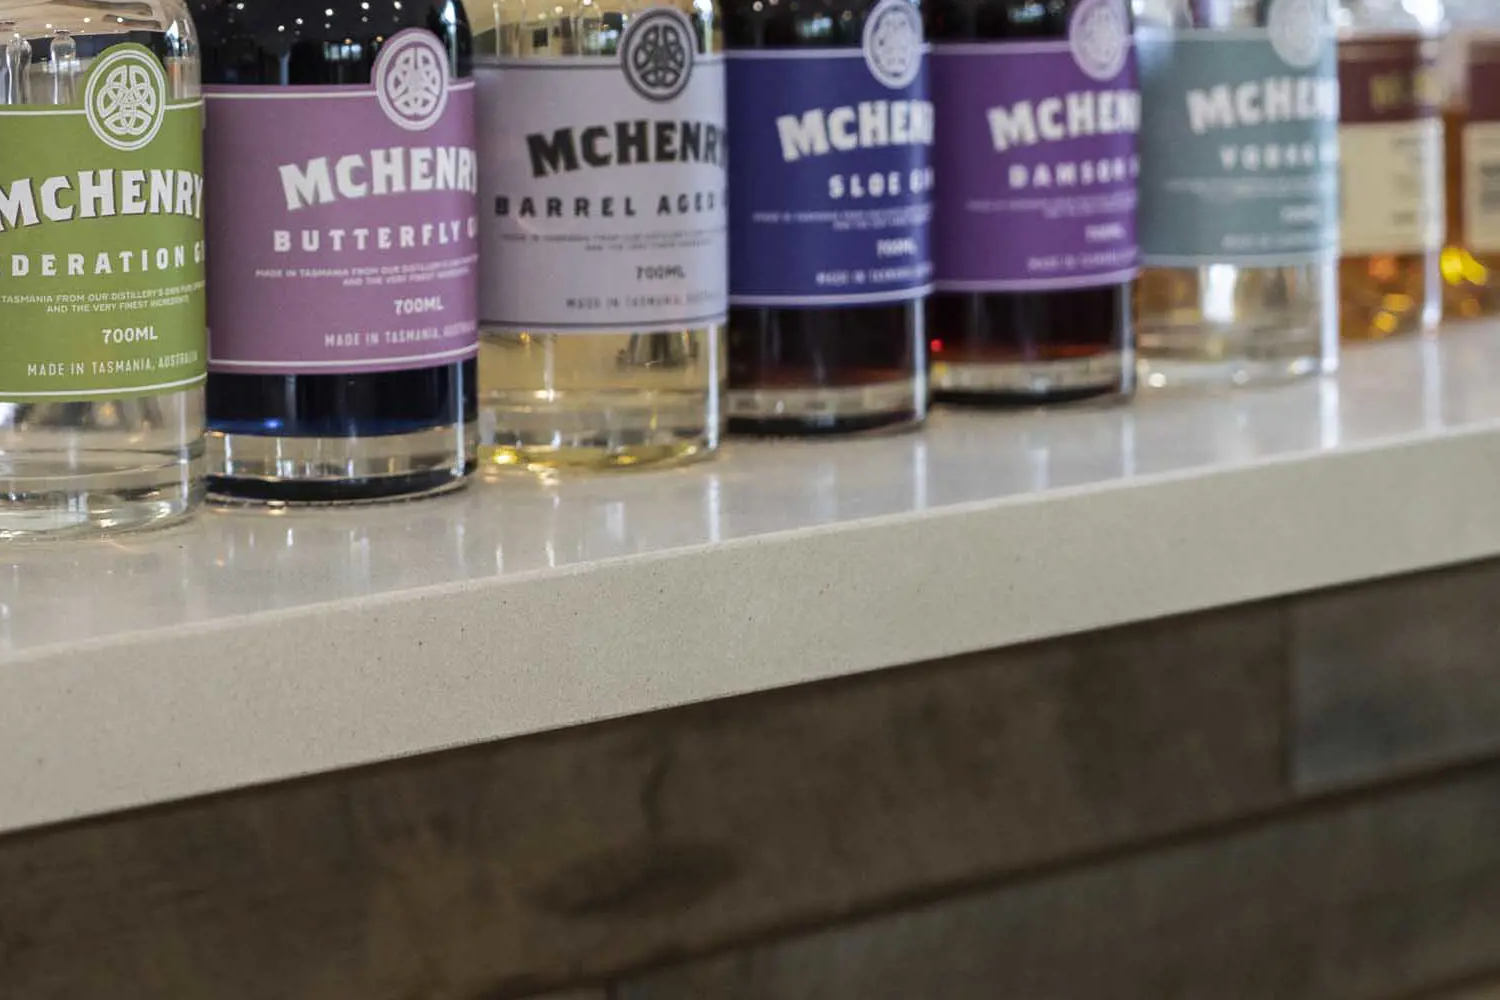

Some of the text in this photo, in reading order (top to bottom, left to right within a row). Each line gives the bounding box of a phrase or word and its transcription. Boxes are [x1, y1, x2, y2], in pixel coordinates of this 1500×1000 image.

[986, 90, 1142, 152] MCHEN
[776, 100, 935, 162] MCHEN
[494, 196, 636, 218] BARREL
[273, 220, 462, 252] BUTTERFLY
[2, 294, 53, 304] TASMANIA
[56, 293, 85, 302] FROM
[46, 303, 69, 313] AND
[71, 303, 90, 312] THE
[92, 302, 117, 312] VERY
[394, 296, 444, 315] 700ML
[102, 326, 159, 345] 700ML
[325, 332, 360, 347] MADE
[366, 331, 380, 345] IN
[27, 362, 66, 377] MADE
[71, 361, 85, 375] IN
[92, 357, 156, 375] TASMANIA,
